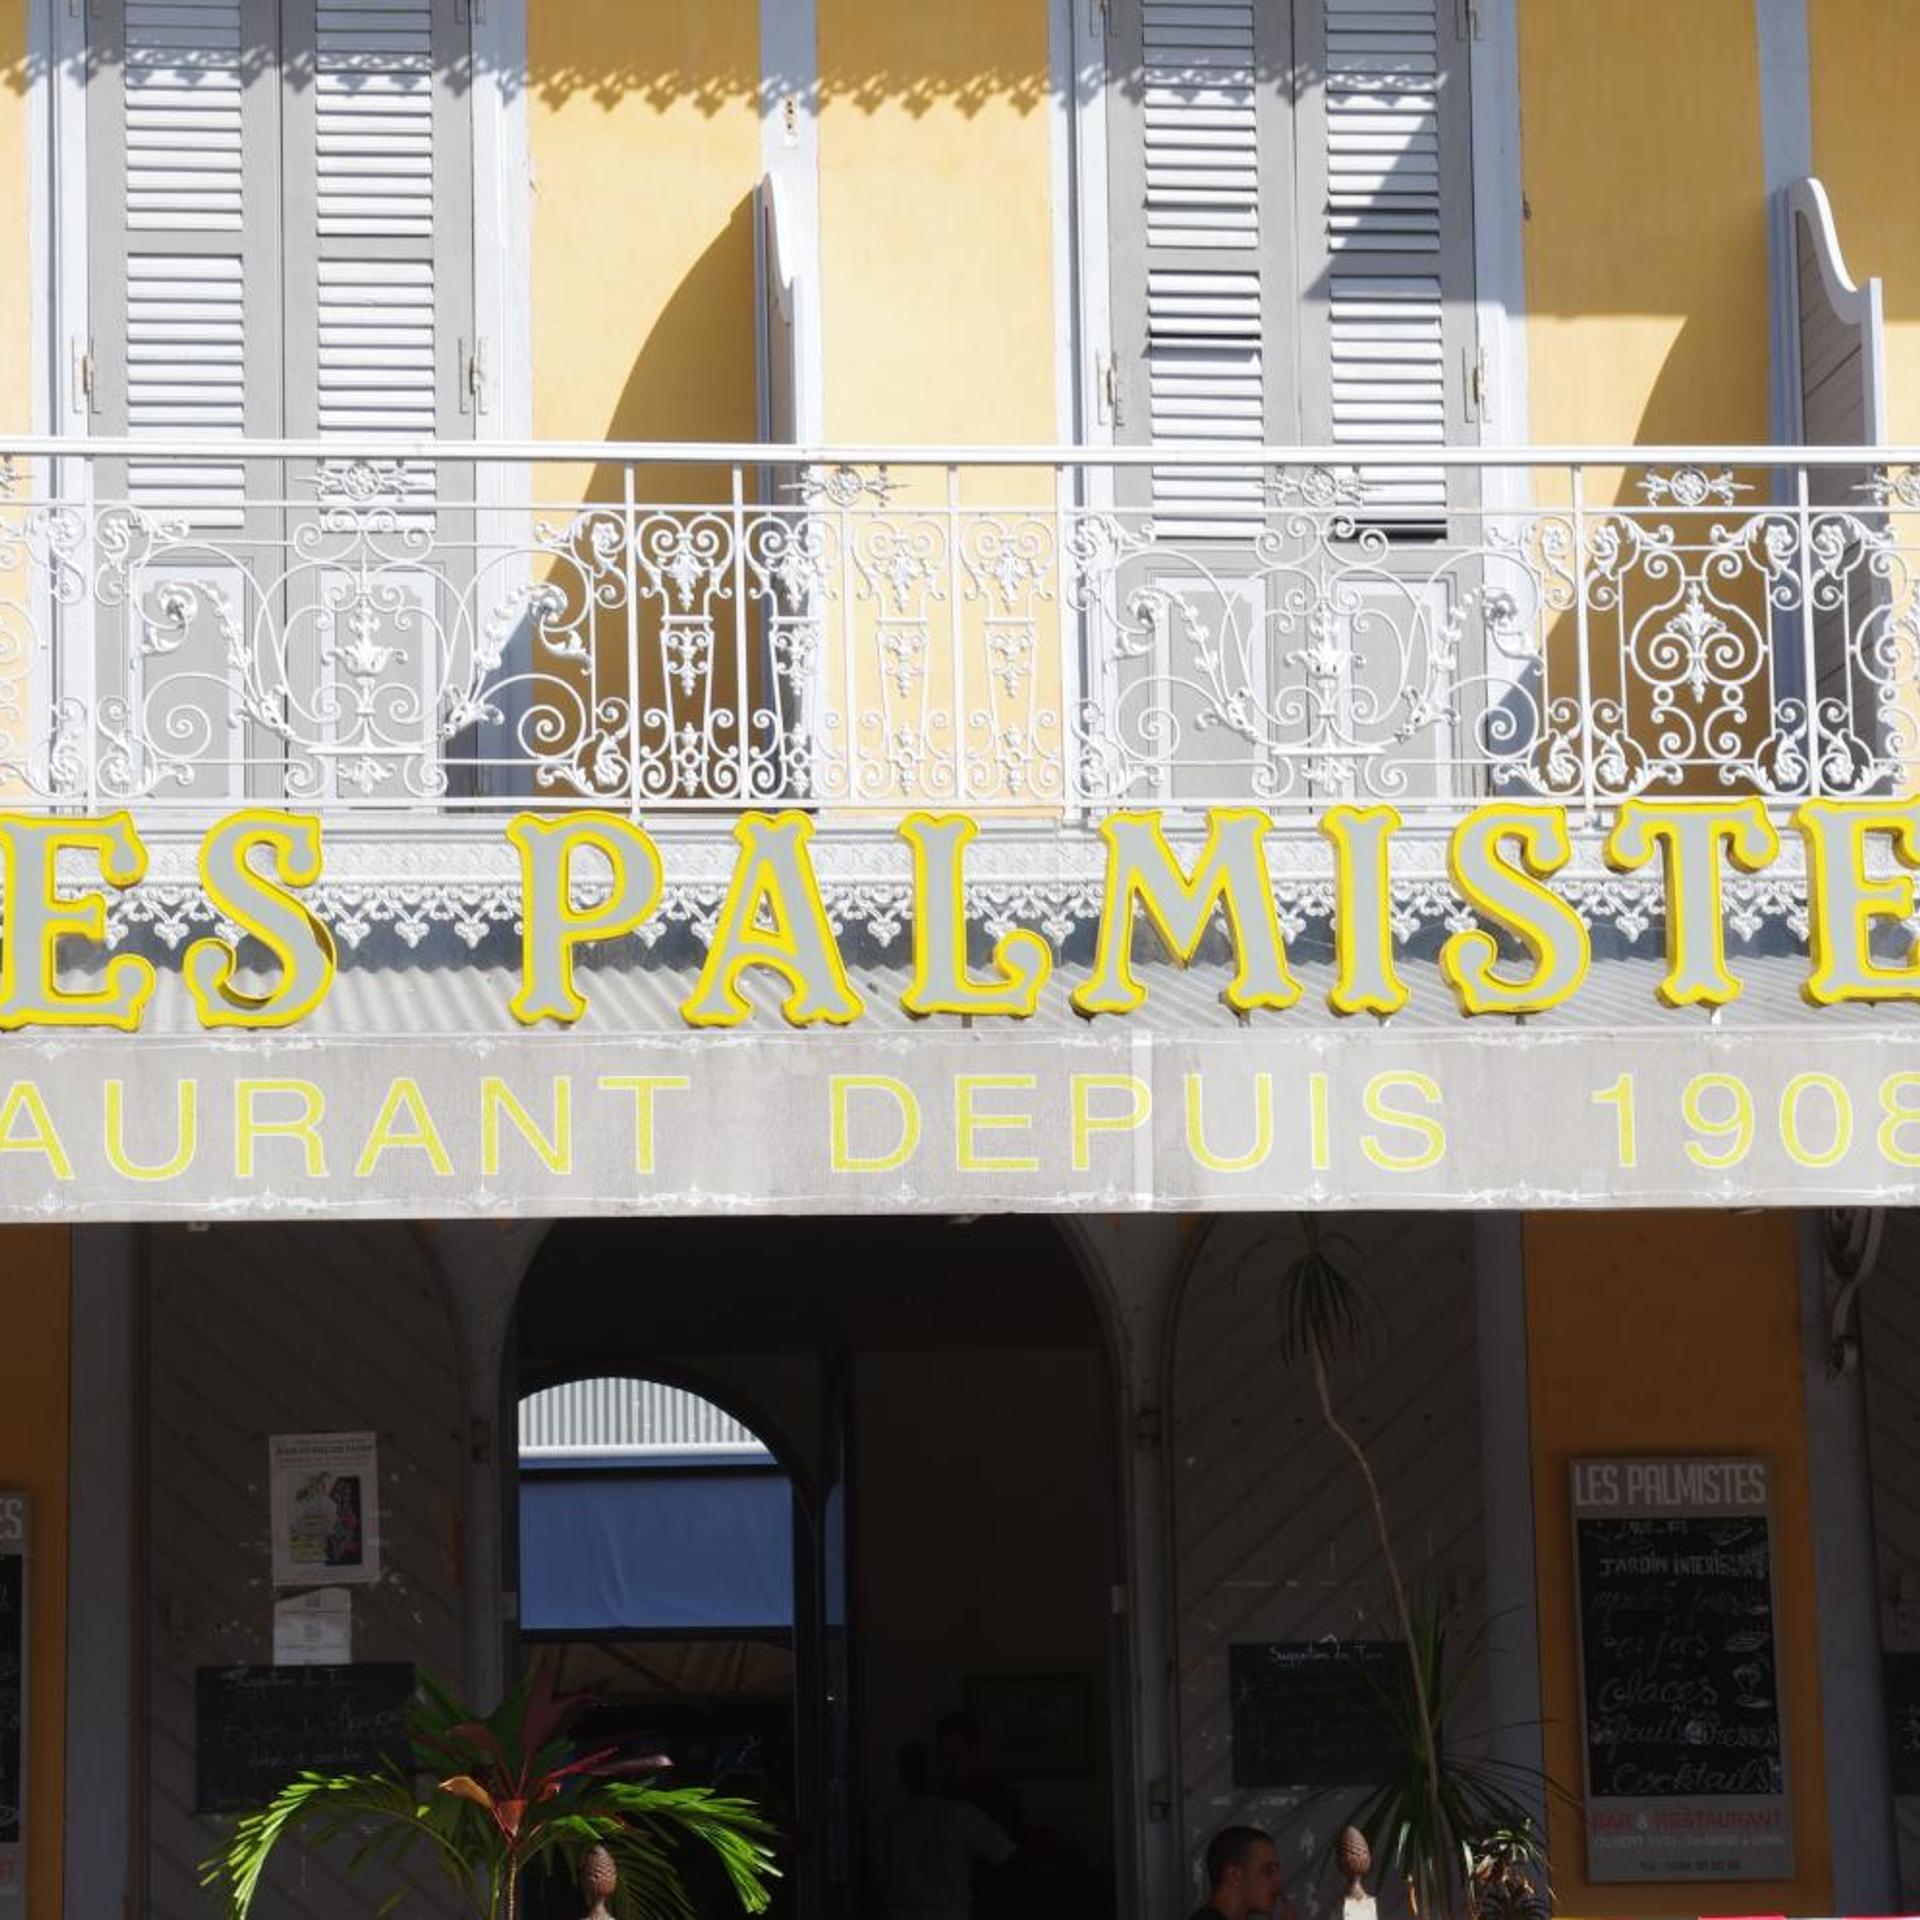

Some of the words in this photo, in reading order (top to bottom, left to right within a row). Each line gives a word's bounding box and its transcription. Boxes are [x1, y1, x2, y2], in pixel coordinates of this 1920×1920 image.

[0, 810, 338, 1031] ES
[506, 795, 1920, 1028] PALMISTE
[0, 1074, 690, 1181] AURANT
[828, 1070, 1447, 1175] DEPUIS
[1574, 1465, 1619, 1506] LES
[1628, 1463, 1767, 1506] PALMISTES
[1592, 1812, 1631, 1831] BAR
[1654, 1808, 1782, 1830] RESTAURANT
